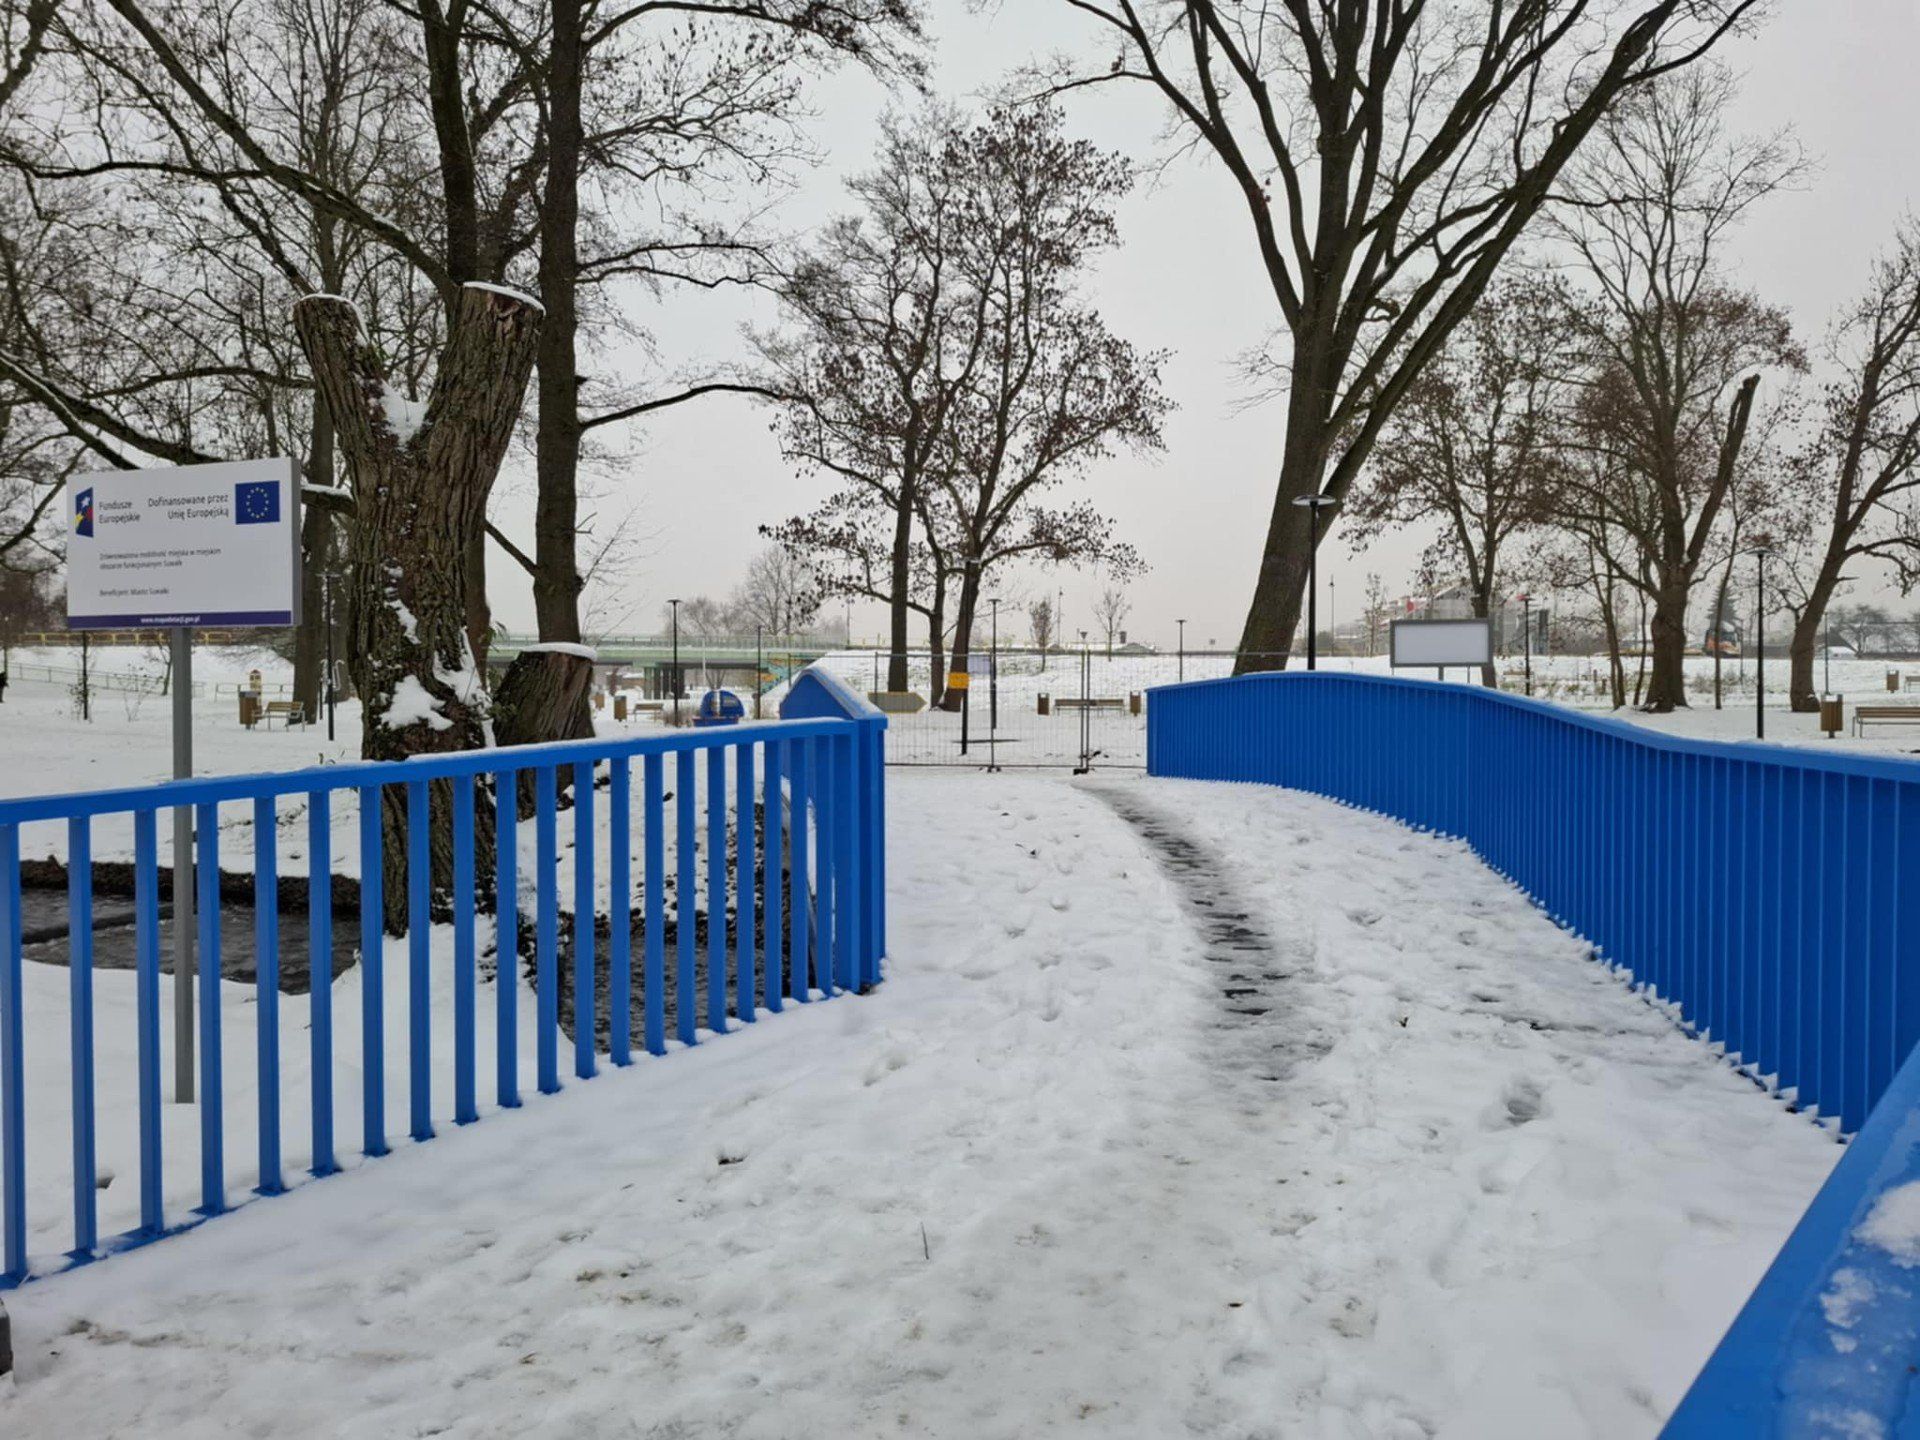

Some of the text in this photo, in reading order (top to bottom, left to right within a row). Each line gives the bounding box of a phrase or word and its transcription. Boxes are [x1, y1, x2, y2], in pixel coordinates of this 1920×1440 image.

[99, 501, 133, 511] Fundusze
[148, 494, 229, 508] Dofinansowane przez
[99, 512, 141, 524] Europejskie
[167, 506, 230, 521] Unię Europejską
